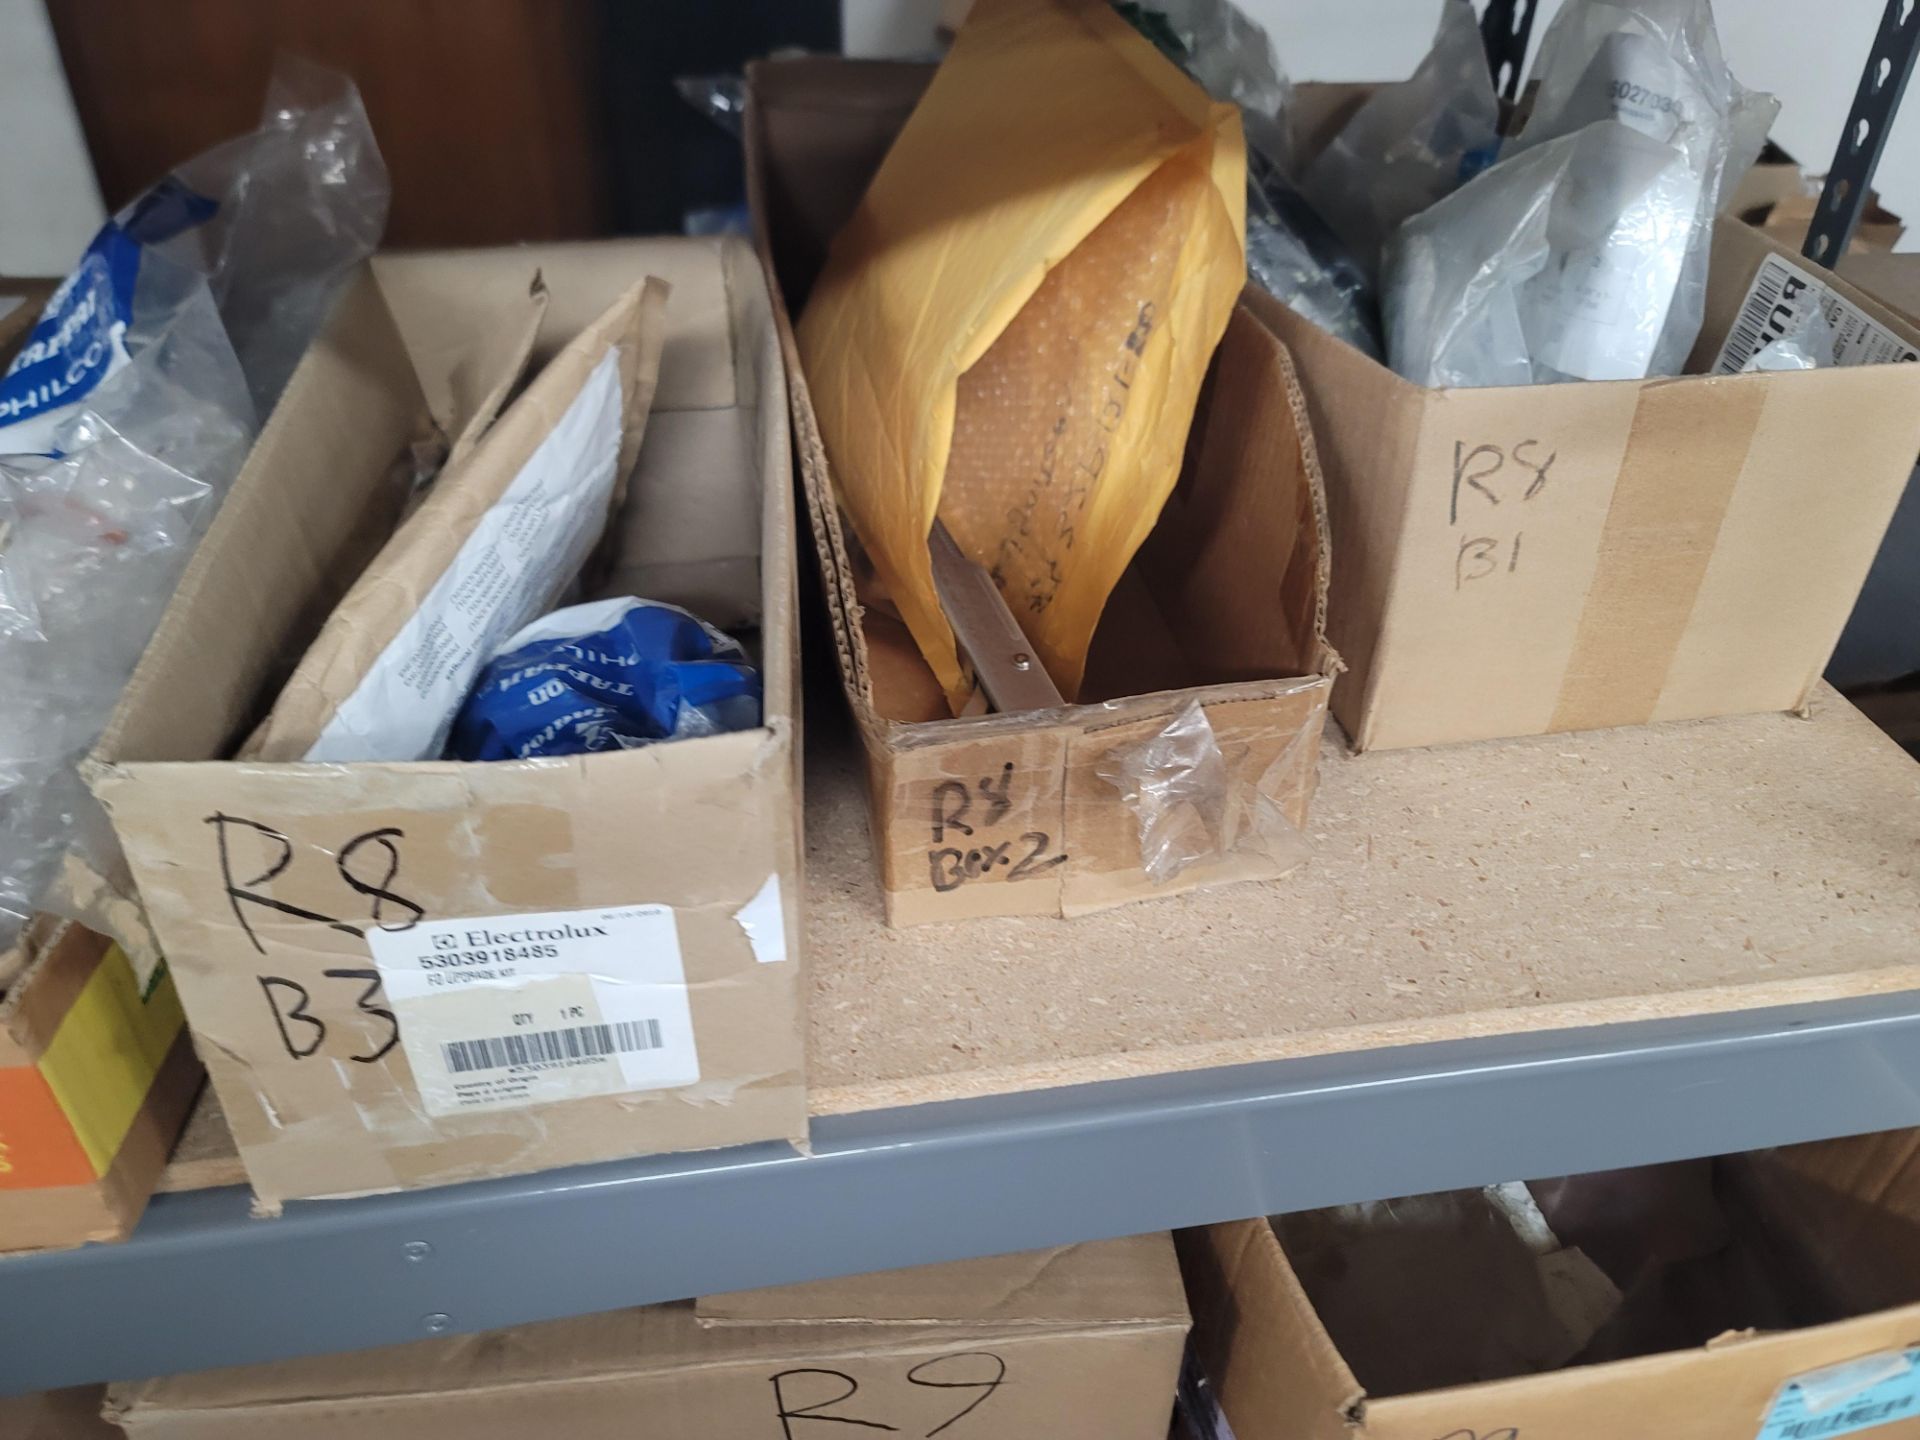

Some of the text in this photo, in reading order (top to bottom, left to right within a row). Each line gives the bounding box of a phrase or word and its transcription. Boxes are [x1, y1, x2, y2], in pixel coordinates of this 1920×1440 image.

[465, 924, 610, 947] Electrolux
[418, 944, 560, 970] 5303918485
[257, 968, 400, 1064] B3
